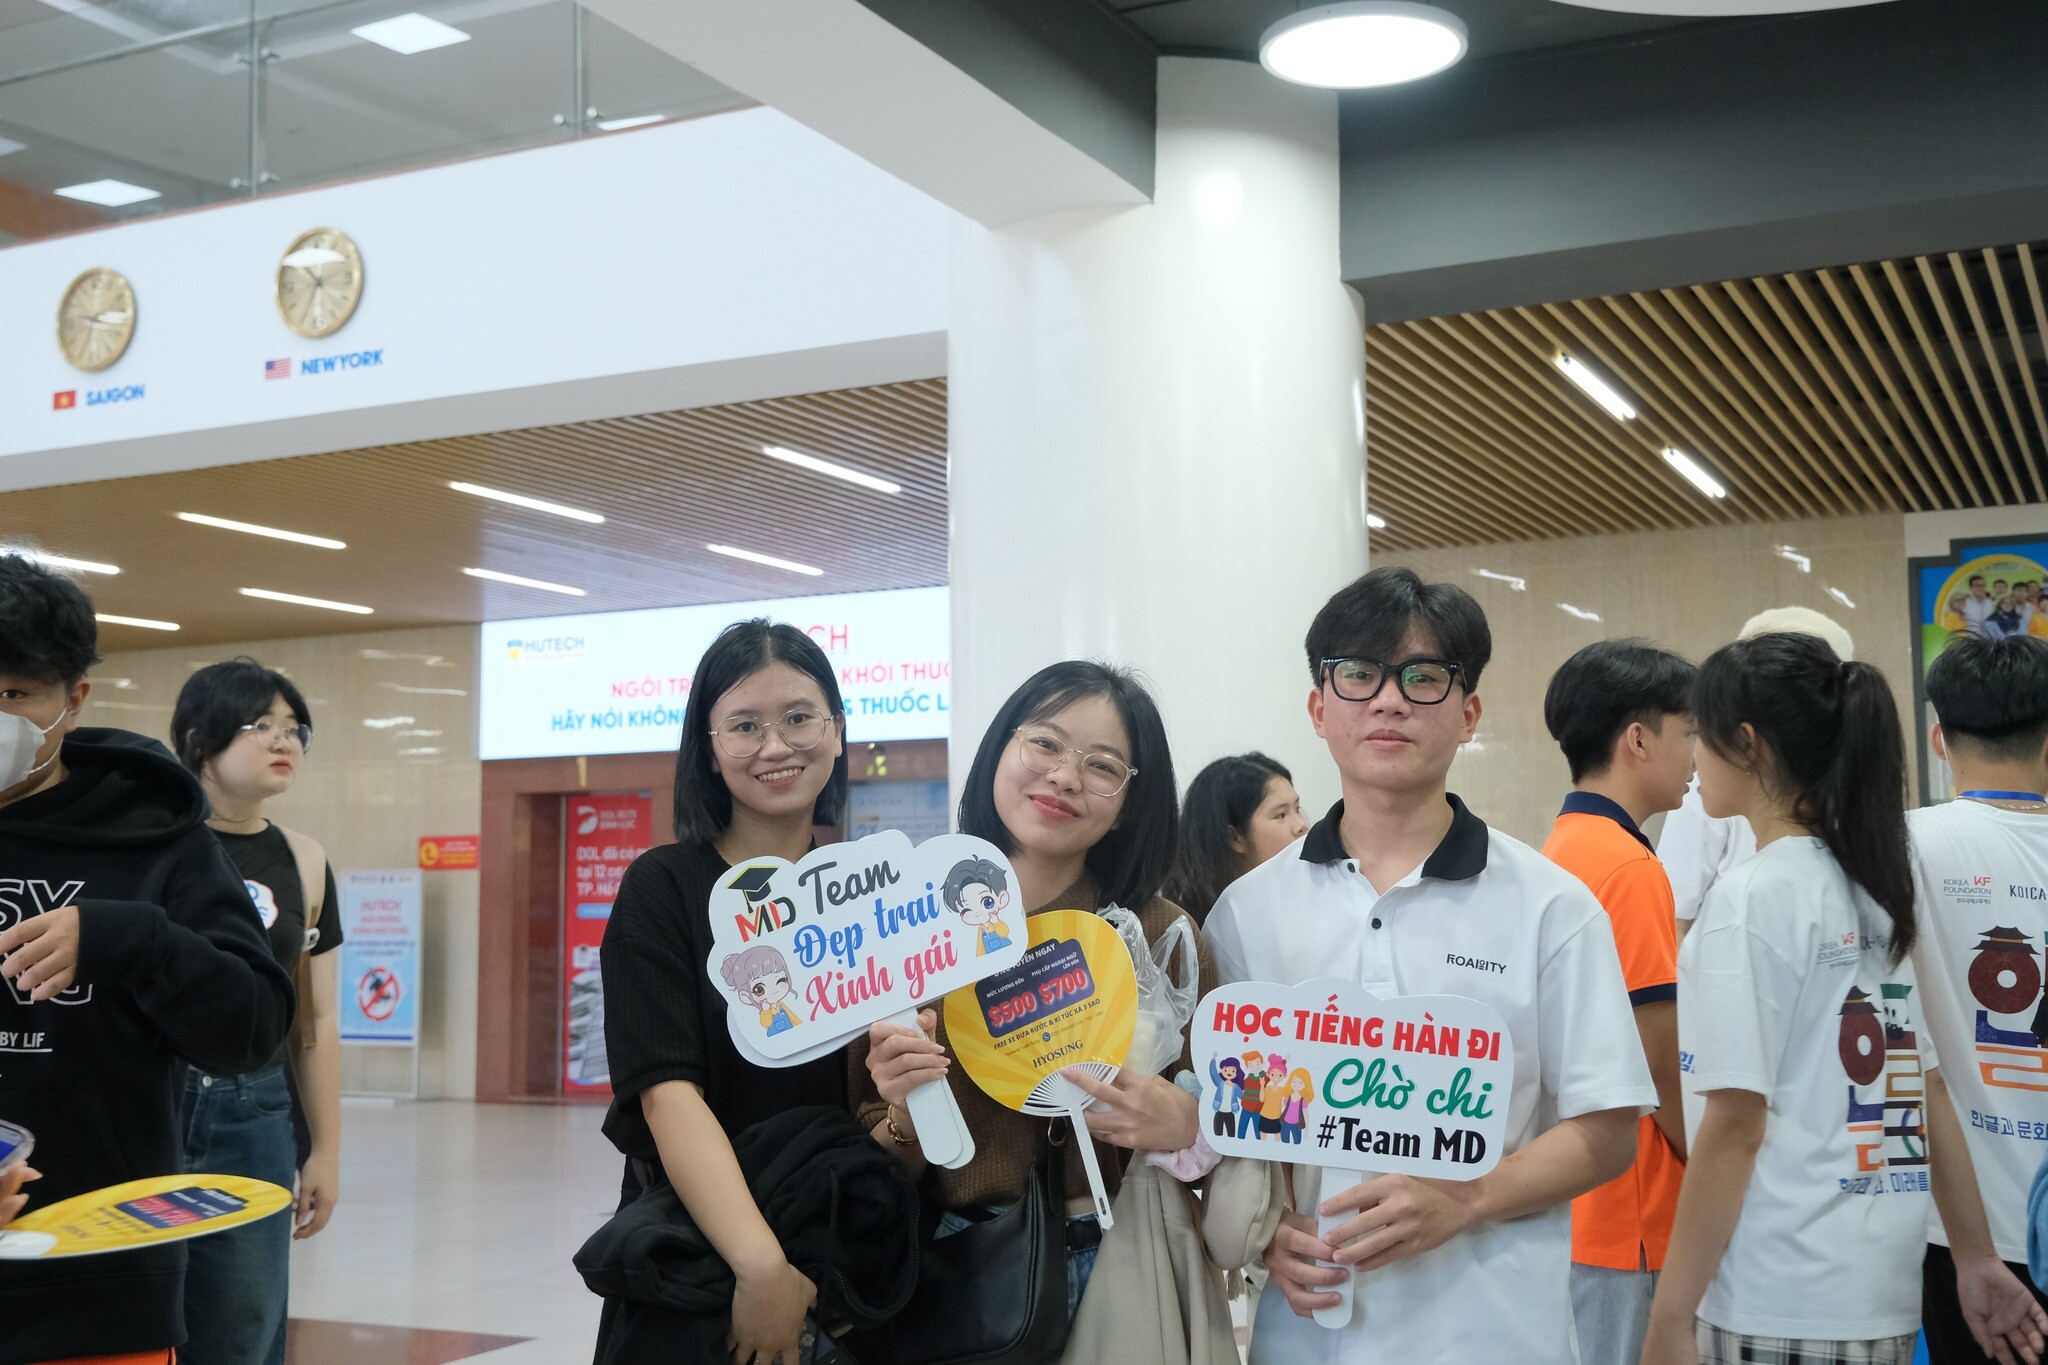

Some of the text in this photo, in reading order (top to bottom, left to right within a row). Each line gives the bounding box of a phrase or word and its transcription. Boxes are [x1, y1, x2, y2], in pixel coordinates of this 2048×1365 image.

[86, 384, 145, 406] SAIGON
[525, 637, 585, 653] HUTECH
[611, 674, 694, 698] NGÔI TR
[859, 687, 930, 715] THUỐC
[937, 693, 949, 711] L
[552, 709, 585, 731] HÃY
[591, 707, 623, 730] NÓI
[798, 859, 901, 915] Team
[1943, 875, 1991, 887] KOREA KF
[1943, 886, 1992, 896] FOUNDATION
[2009, 884, 2048, 901] KOICA
[735, 896, 796, 943] MD
[793, 882, 941, 969] Đẹp trai
[1035, 943, 1056, 958] NGAY
[805, 929, 958, 1022] Xinh gái
[988, 967, 1088, 1028] $500 $700
[993, 1040, 1007, 1050] FREE
[1008, 1036, 1016, 1044] XE
[1016, 1030, 1030, 1040] ĐƯA
[1061, 1010, 1073, 1020] TÚC
[1087, 998, 1101, 1009] SAO
[1213, 993, 1501, 1061] HỌC TIẾNG HÀN ĐI
[1032, 1039, 1084, 1068] HYOSUNG
[1322, 1057, 1495, 1119] Chờ chi
[1970, 1109, 2015, 1136] 한글과
[1316, 1115, 1487, 1165] #Team MD
